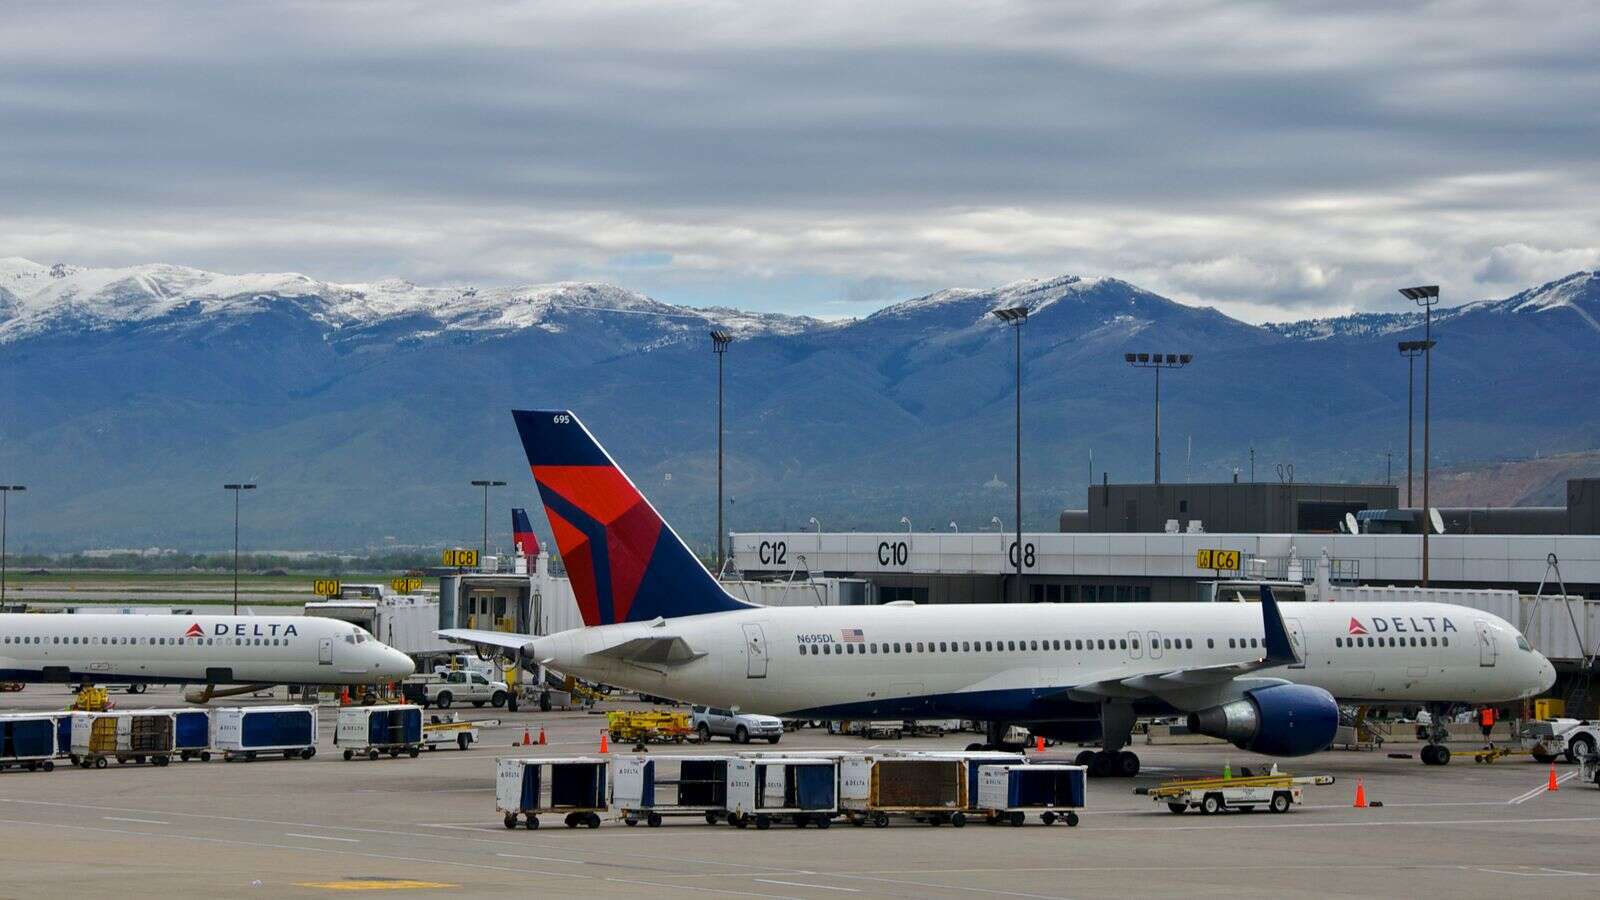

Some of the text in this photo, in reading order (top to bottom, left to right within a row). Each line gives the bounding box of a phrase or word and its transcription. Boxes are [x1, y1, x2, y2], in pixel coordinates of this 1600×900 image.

[553, 415, 570, 424] 695
[459, 551, 473, 565] C8
[759, 541, 787, 566] C12
[877, 542, 908, 567] C10
[1217, 552, 1234, 568] C6
[317, 580, 335, 594] C10
[214, 623, 298, 637] DELTA
[1372, 617, 1457, 633] DELTA
[797, 633, 836, 644] N695DL
